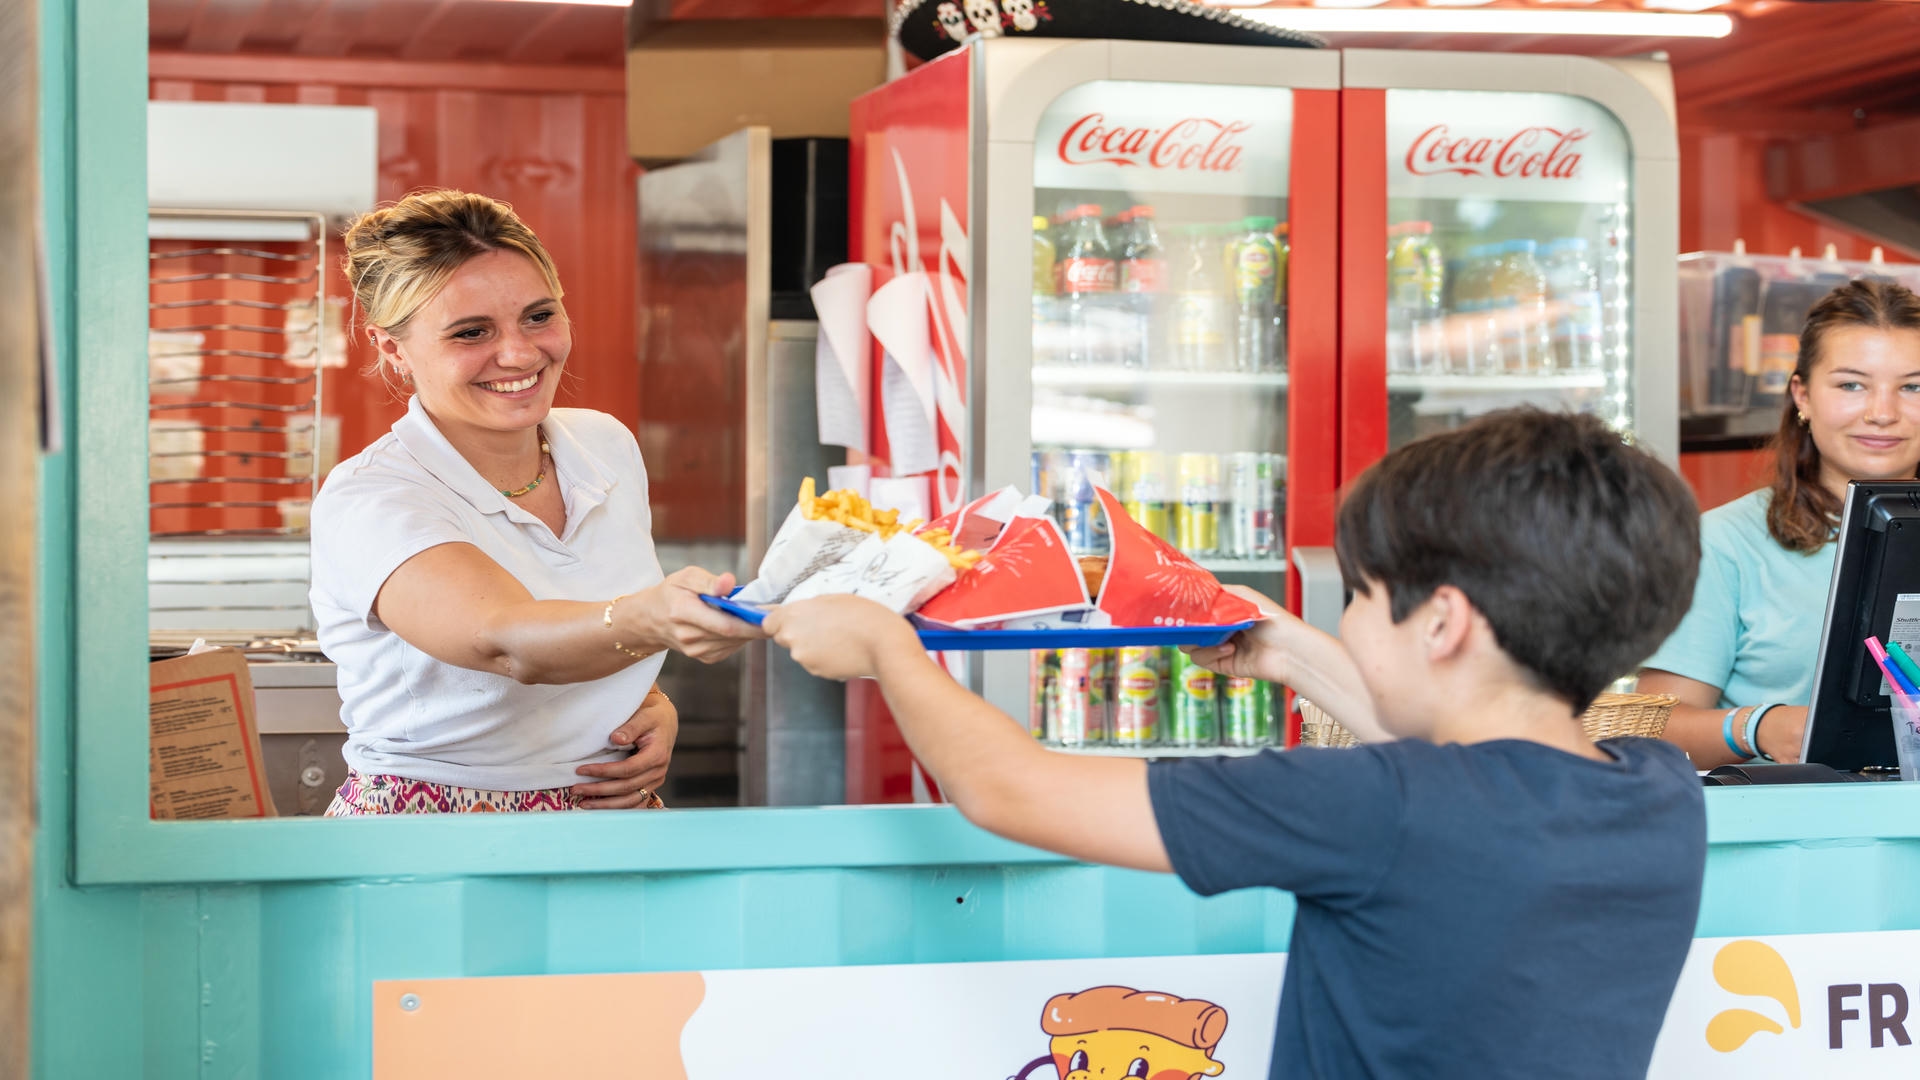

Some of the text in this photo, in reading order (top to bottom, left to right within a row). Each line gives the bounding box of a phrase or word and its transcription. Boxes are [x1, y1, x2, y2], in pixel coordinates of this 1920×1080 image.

[1058, 112, 1252, 173] Coca-Cola
[1405, 124, 1591, 179] Coca-Cola
[1827, 982, 1920, 1050] FR
